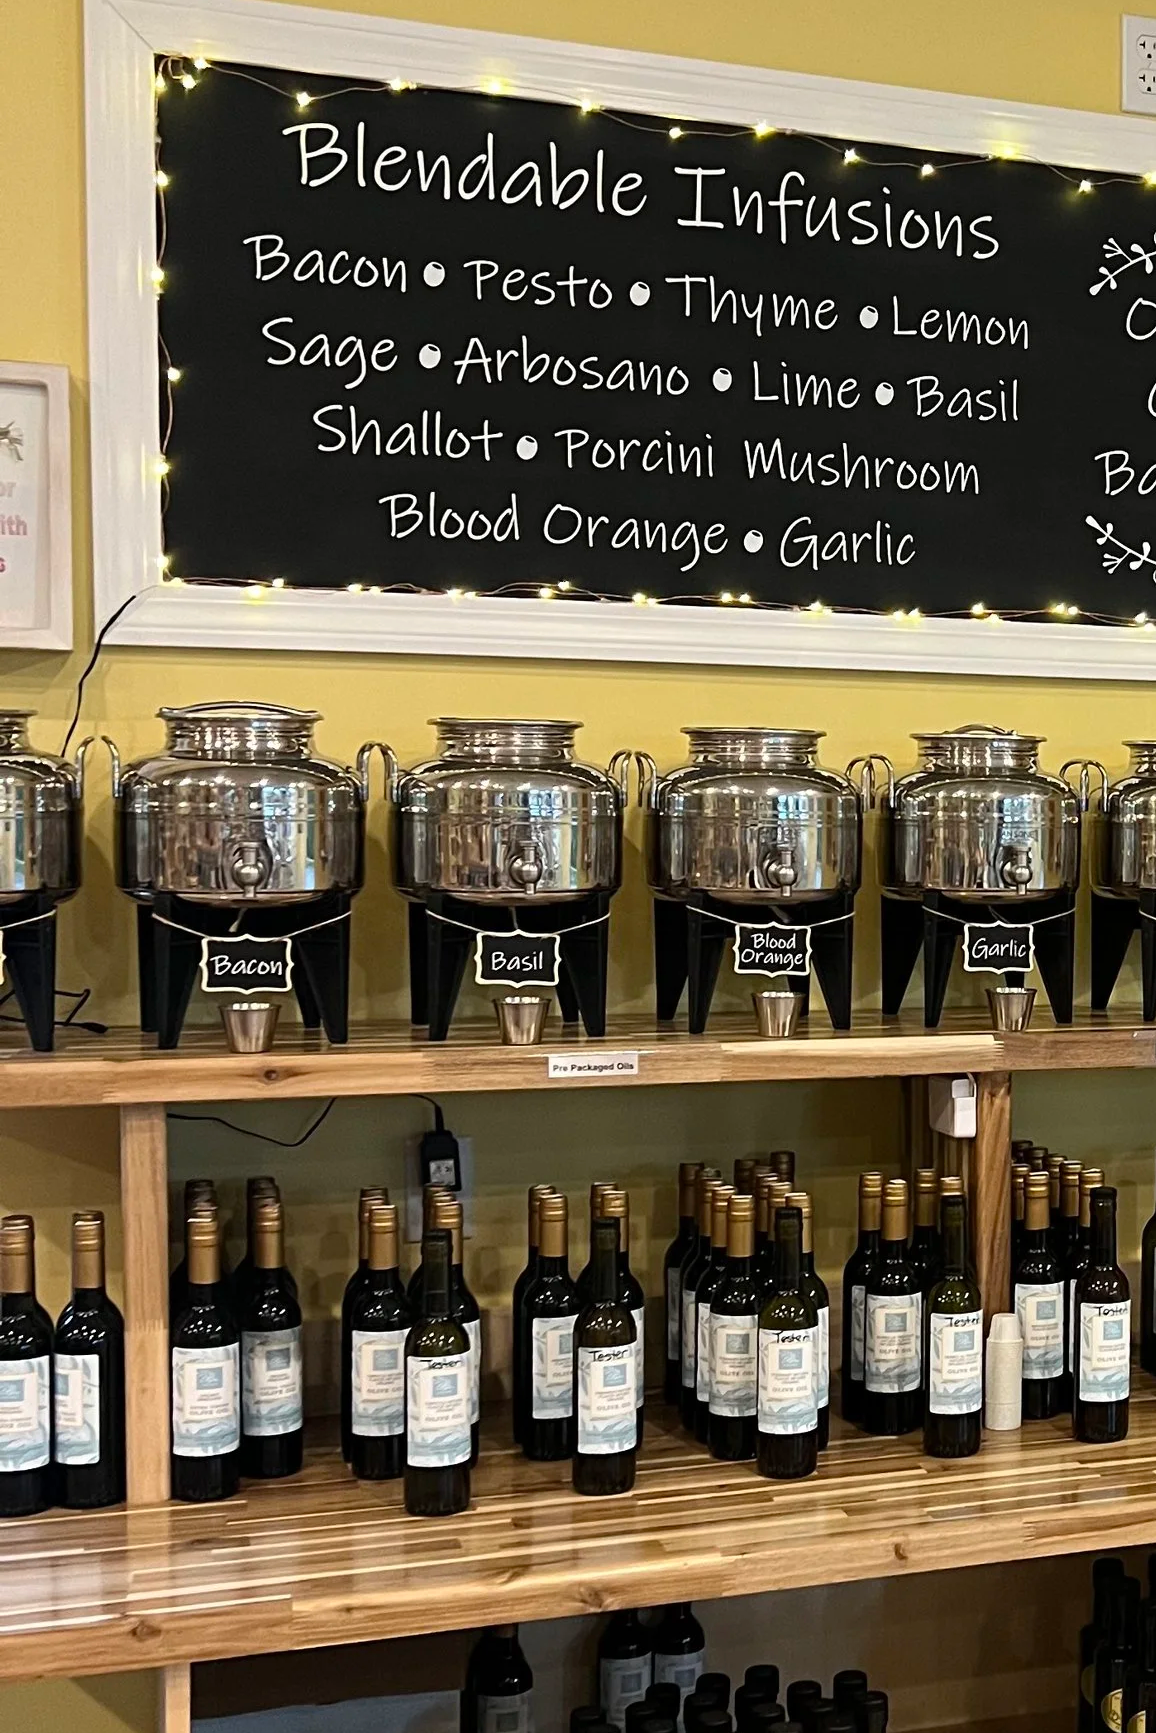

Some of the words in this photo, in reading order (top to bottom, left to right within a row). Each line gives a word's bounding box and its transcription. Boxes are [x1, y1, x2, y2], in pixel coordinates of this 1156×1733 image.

[281, 119, 648, 217] Blendable
[672, 166, 1000, 260] Infusions
[242, 234, 407, 293] Bacon
[463, 259, 613, 309] Pesto
[664, 274, 839, 337] Thyme
[892, 295, 1029, 350] Lemon
[261, 316, 398, 390] Sage
[453, 334, 690, 396] Arbosano
[752, 360, 861, 409] Lime
[906, 375, 1019, 422] Basil
[312, 404, 504, 462] Shallot
[554, 428, 714, 478] Porcini
[743, 437, 980, 495] Mushroom
[378, 491, 520, 542] Blood
[543, 503, 729, 572] Orange
[779, 516, 916, 571] Garlic
[750, 932, 797, 950] Blood
[971, 937, 1027, 960] Garlic
[209, 954, 283, 976] Bacon
[491, 950, 544, 972] Basil
[740, 947, 804, 968] Orange
[553, 1064, 568, 1072] Pre
[570, 1063, 614, 1072] Packaged
[617, 1062, 634, 1070] Oils
[944, 1316, 981, 1327] Tester
[588, 1349, 629, 1362] Tester
